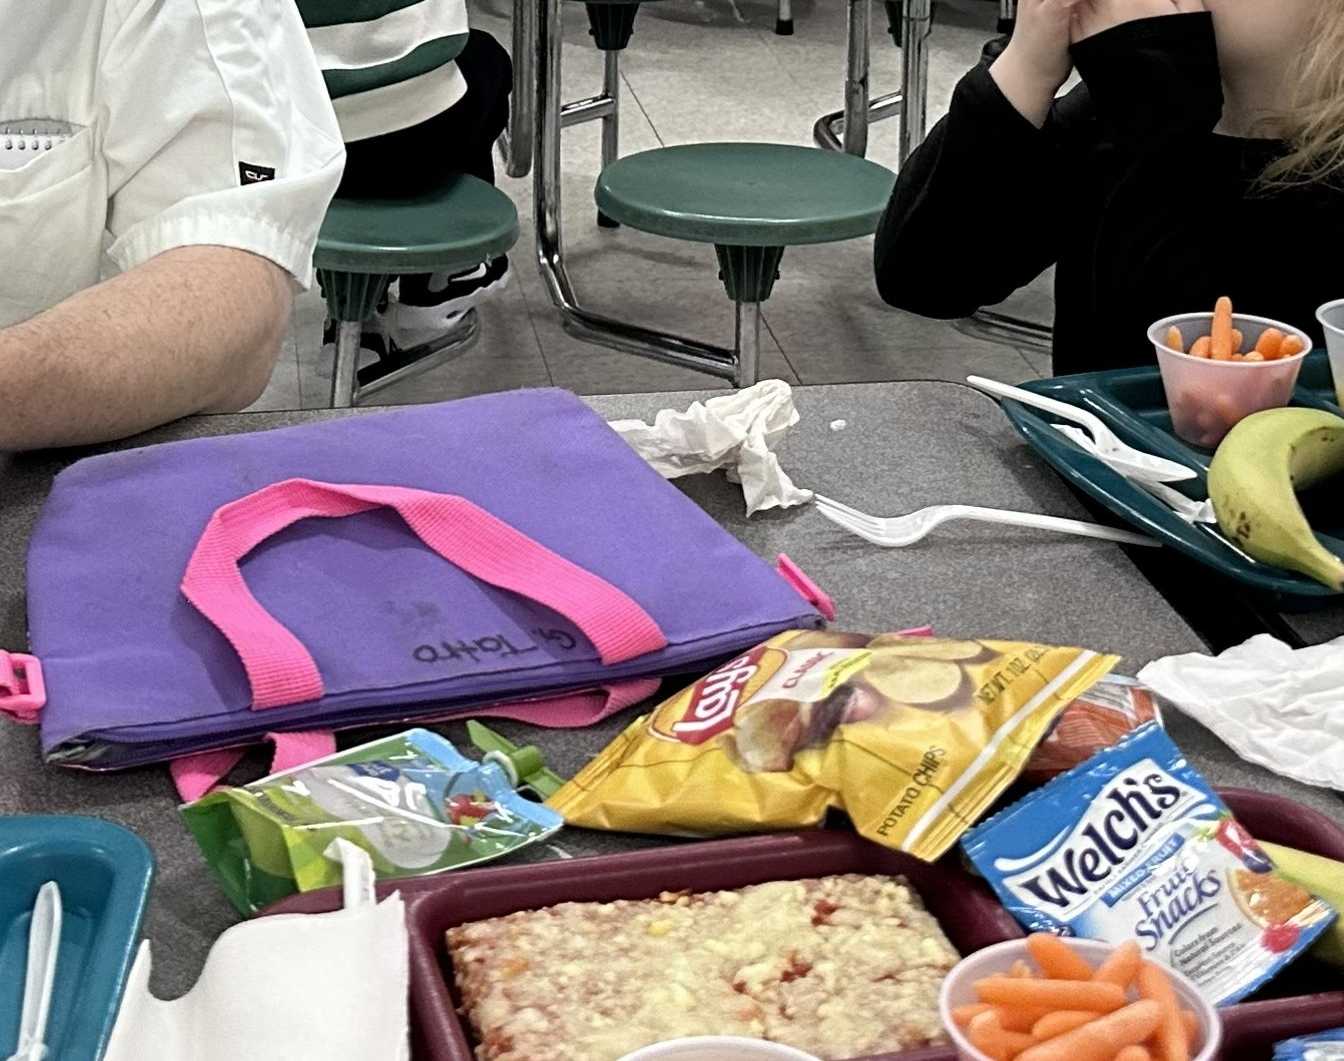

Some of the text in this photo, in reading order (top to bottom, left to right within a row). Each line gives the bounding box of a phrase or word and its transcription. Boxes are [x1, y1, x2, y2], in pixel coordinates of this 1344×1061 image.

[876, 744, 947, 837] POTATO CHIPS
[1019, 772, 1182, 909] Welch's
[1134, 868, 1225, 952] Snacks
